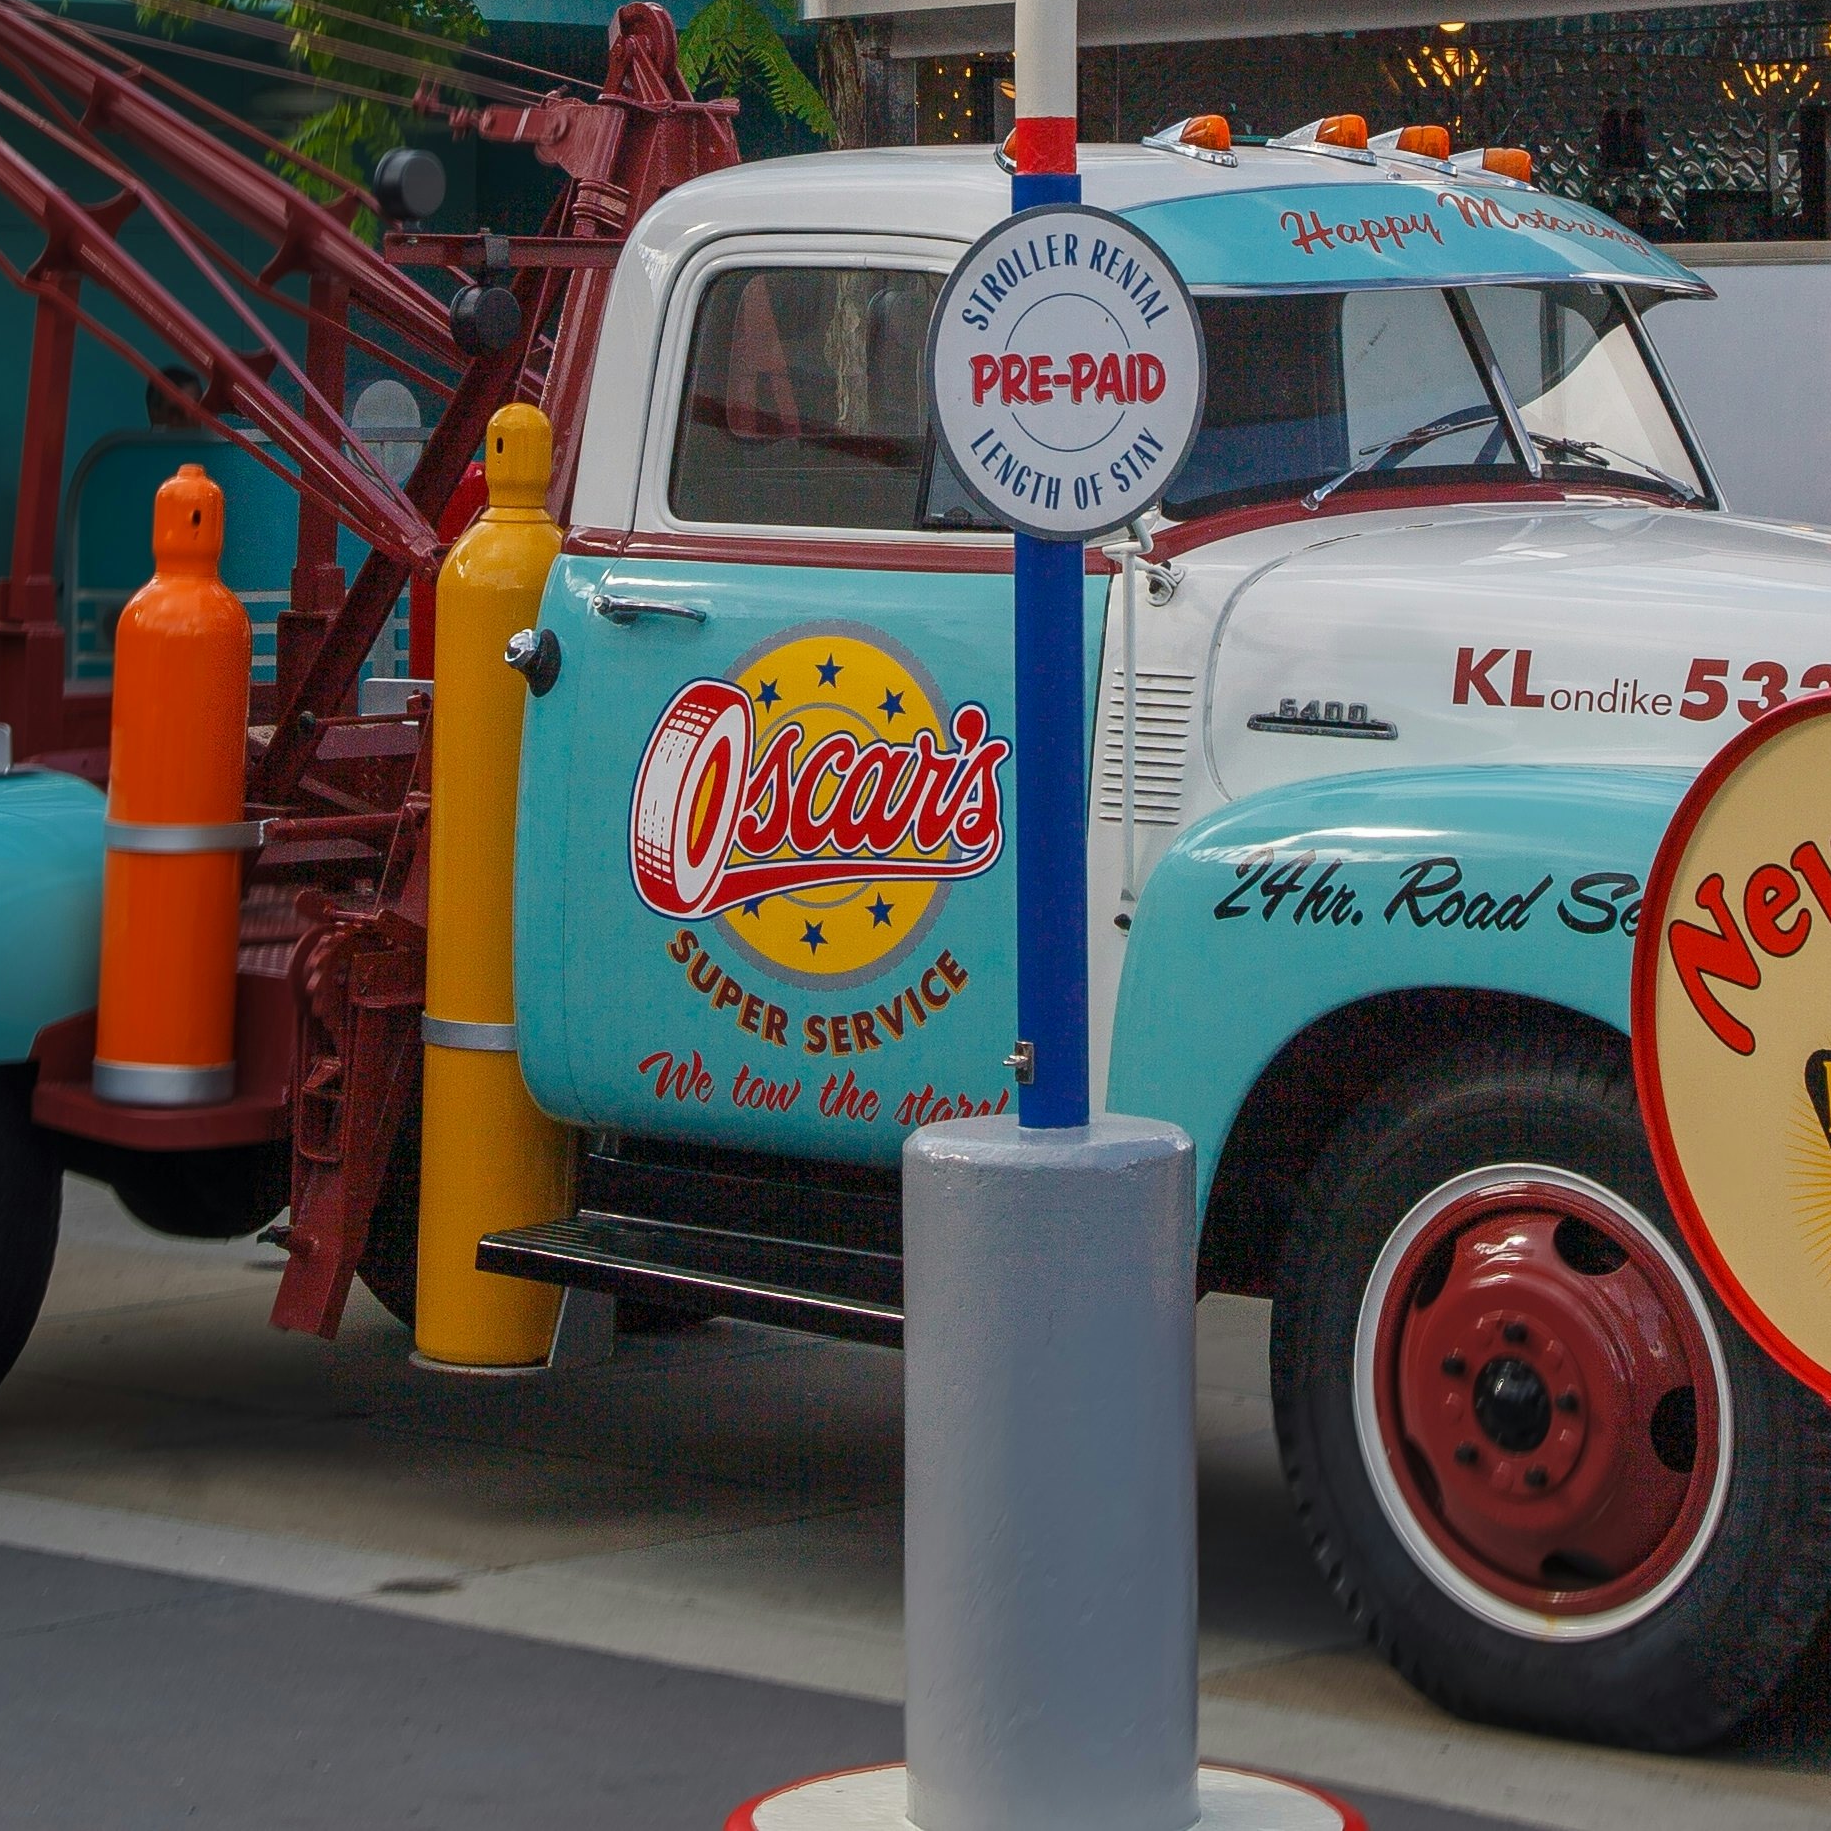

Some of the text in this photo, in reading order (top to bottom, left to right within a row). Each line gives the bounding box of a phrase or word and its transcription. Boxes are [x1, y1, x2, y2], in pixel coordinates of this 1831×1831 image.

[1280, 191, 1651, 258] Happy Motoring
[962, 233, 1170, 331] STROLLER RENTAL
[969, 352, 1166, 407] PRE-PAID
[970, 427, 1165, 510] LENGTH OF STAY
[630, 677, 1013, 920] Oscar's
[1213, 847, 1364, 928] 24hr.
[1382, 856, 1553, 933] Road
[667, 929, 969, 1058] SUPER SERVICE
[638, 1050, 715, 1104] We
[733, 1063, 802, 1113] tow
[819, 1068, 881, 1123] the
